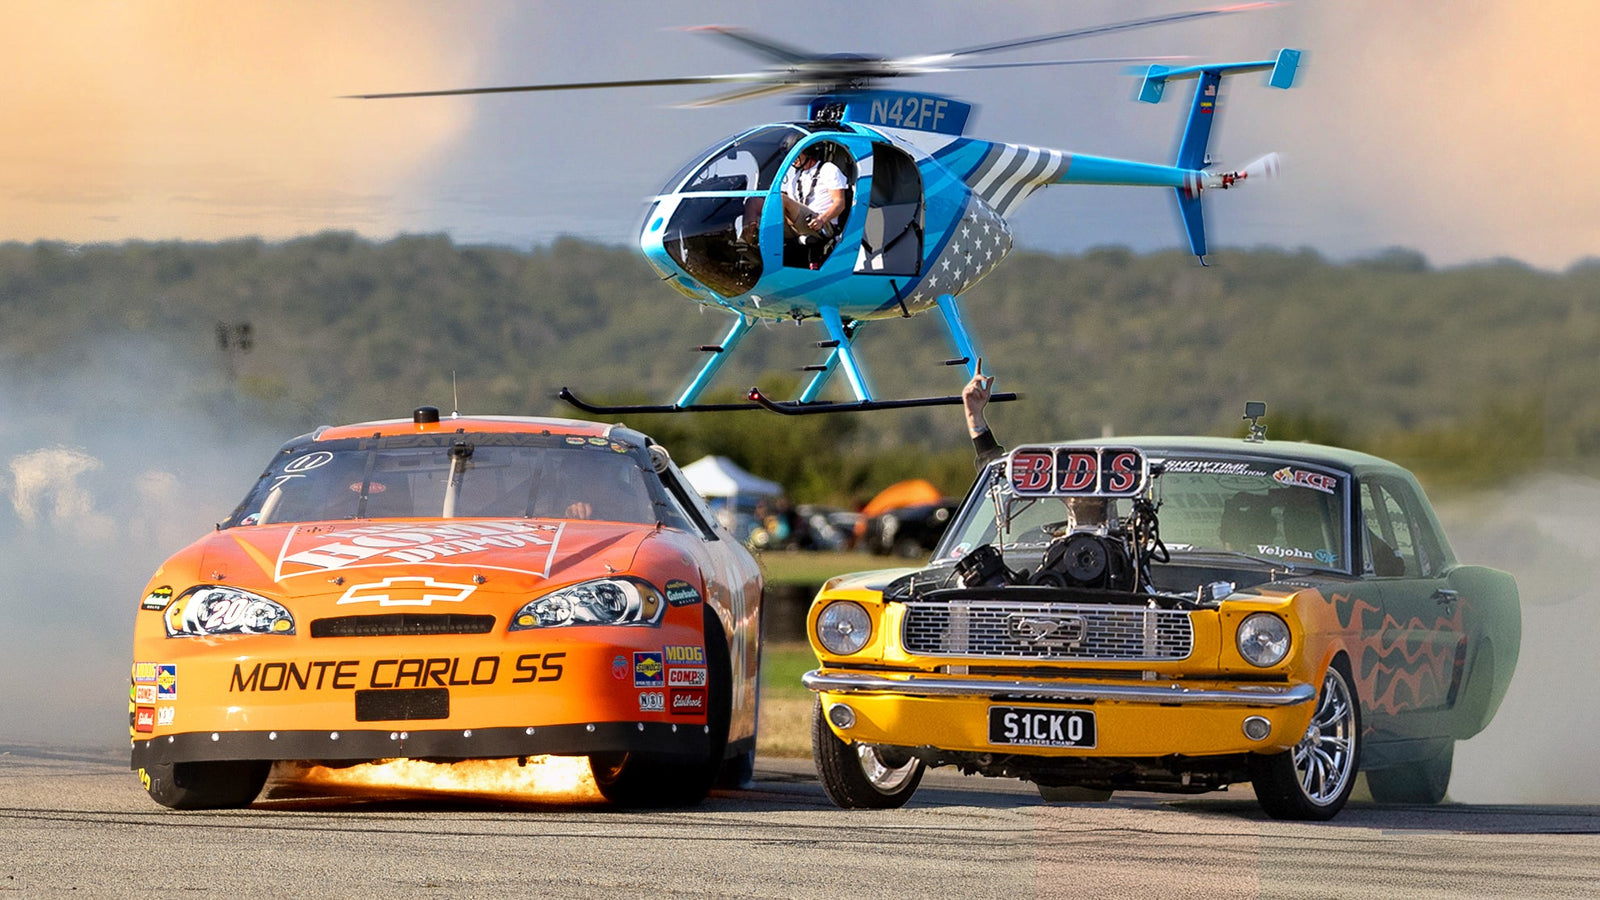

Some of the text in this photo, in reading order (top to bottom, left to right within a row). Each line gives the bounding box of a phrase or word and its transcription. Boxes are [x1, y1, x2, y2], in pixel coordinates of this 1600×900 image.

[869, 97, 948, 130] N42FF
[1012, 453, 1136, 491] BDS
[384, 533, 552, 562] DEPOT
[1256, 545, 1314, 560] Veljohn
[205, 598, 251, 629] 20
[665, 646, 703, 661] MOOG
[230, 652, 566, 692] MONTE CARLO SS
[670, 671, 698, 683] COMP
